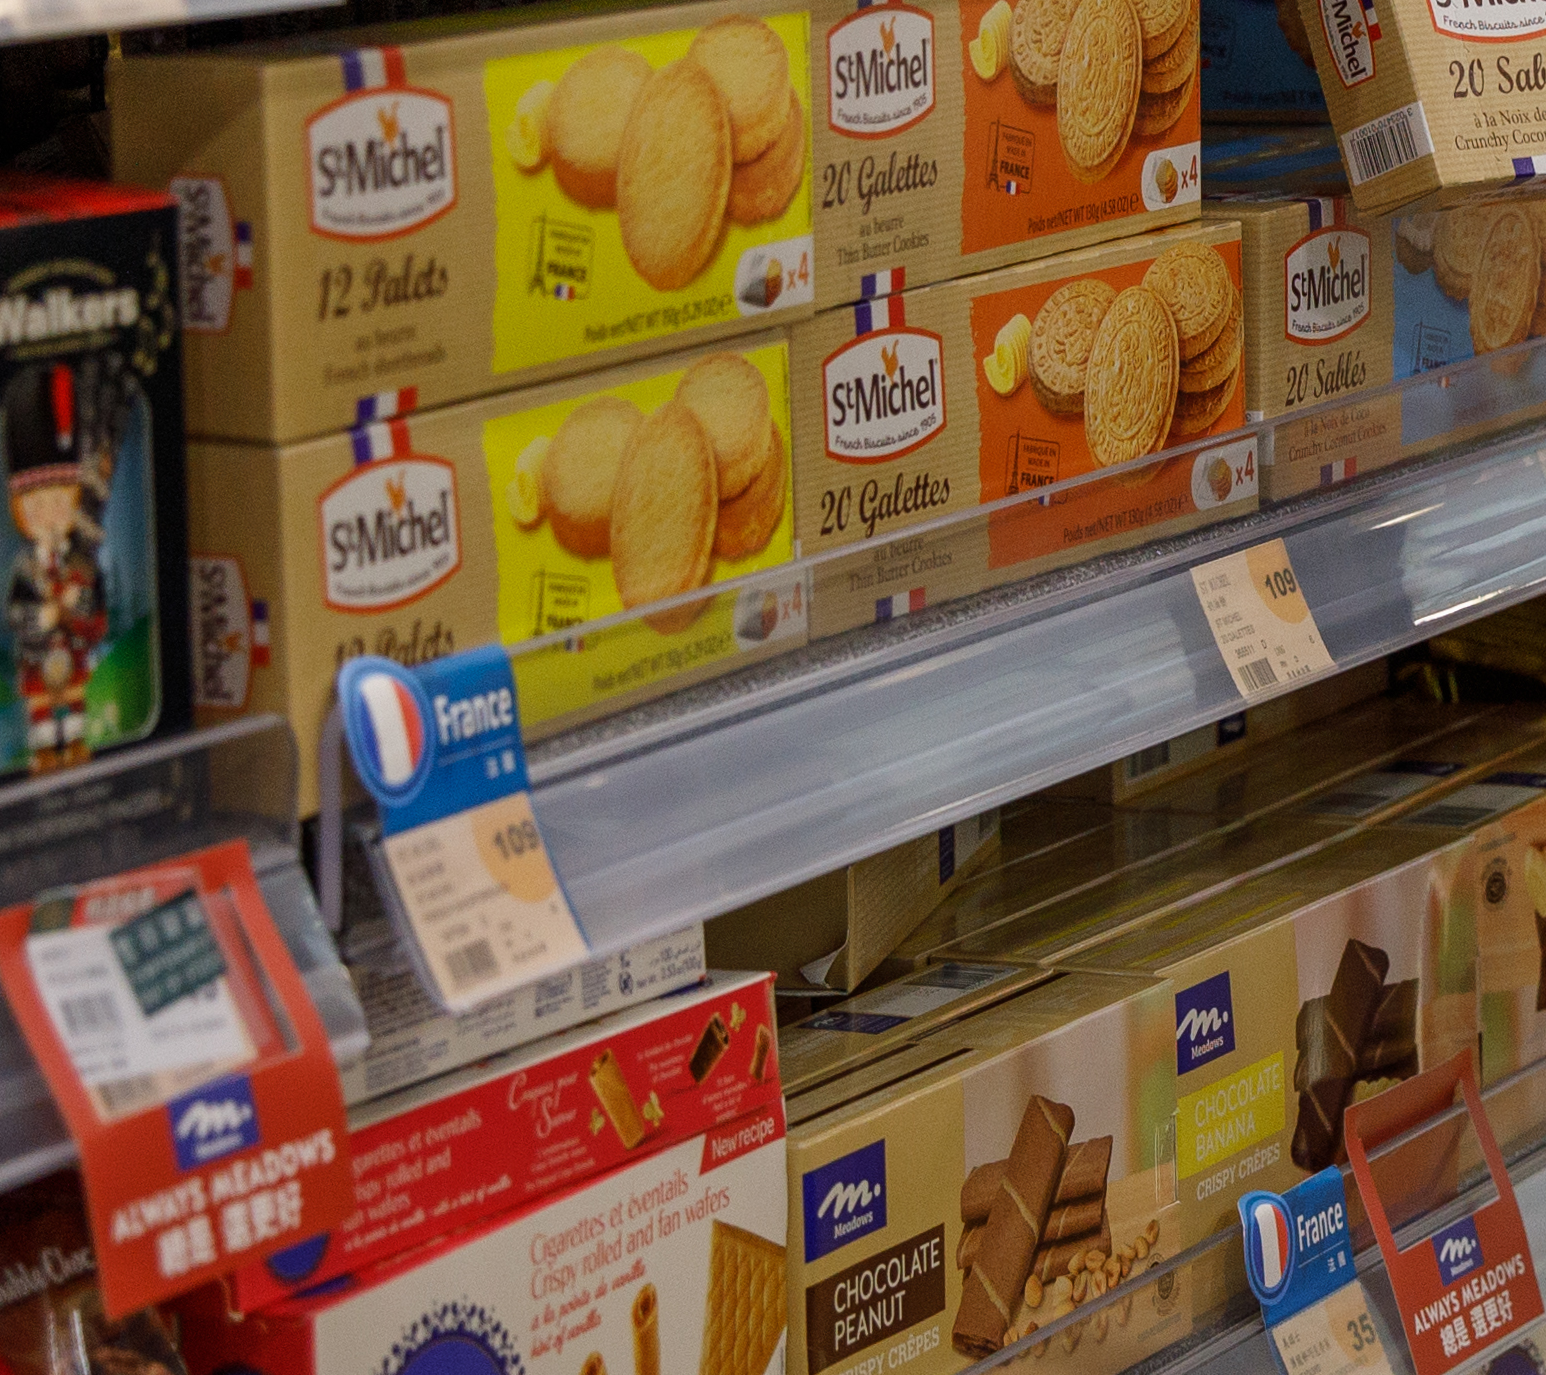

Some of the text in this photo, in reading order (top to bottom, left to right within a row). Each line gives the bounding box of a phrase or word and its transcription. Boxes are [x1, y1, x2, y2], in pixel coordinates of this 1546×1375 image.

[1443, 15, 1477, 30] French
[1478, 20, 1518, 31] Biscuits
[1519, 15, 1545, 29] since
[1449, 58, 1485, 99] 20
[1454, 132, 1510, 153] Crunchy
[1474, 113, 1482, 128] à
[1484, 112, 1497, 127] la
[1500, 108, 1531, 126] Noix
[822, 151, 938, 215] 20 Galettes
[999, 159, 1030, 180] FRANCE
[1181, 155, 1198, 190] x4
[318, 253, 448, 322] 12 Palets
[1285, 351, 1366, 407] 20 Sablés
[1235, 455, 1254, 489] x4
[820, 471, 950, 538] 20 Galettes
[1265, 568, 1297, 599] 109
[434, 685, 512, 744] France
[1189, 1035, 1224, 1063] Meadows
[1194, 1062, 1281, 1127] CHOCOLATE
[712, 1115, 775, 1162] New recipe
[1194, 1110, 1256, 1163] BANANA
[112, 1180, 206, 1244] ALWAYS
[211, 1132, 335, 1202] MEADOWS
[1196, 1141, 1281, 1201] CRISPY CRÊPES
[530, 1169, 689, 1267] Cigarettes et éventails
[531, 1185, 731, 1300] Crispy rolled and fan wafers
[833, 1210, 873, 1242] Meadows
[1296, 1201, 1344, 1252] France
[833, 1235, 942, 1313] CHOCOLATE
[1414, 1254, 1526, 1335] ALWAYS MEADOWS
[833, 1288, 907, 1351] PEANUT
[1347, 1313, 1376, 1351] 35
[1439, 1293, 1514, 1357] 總是 還更好
